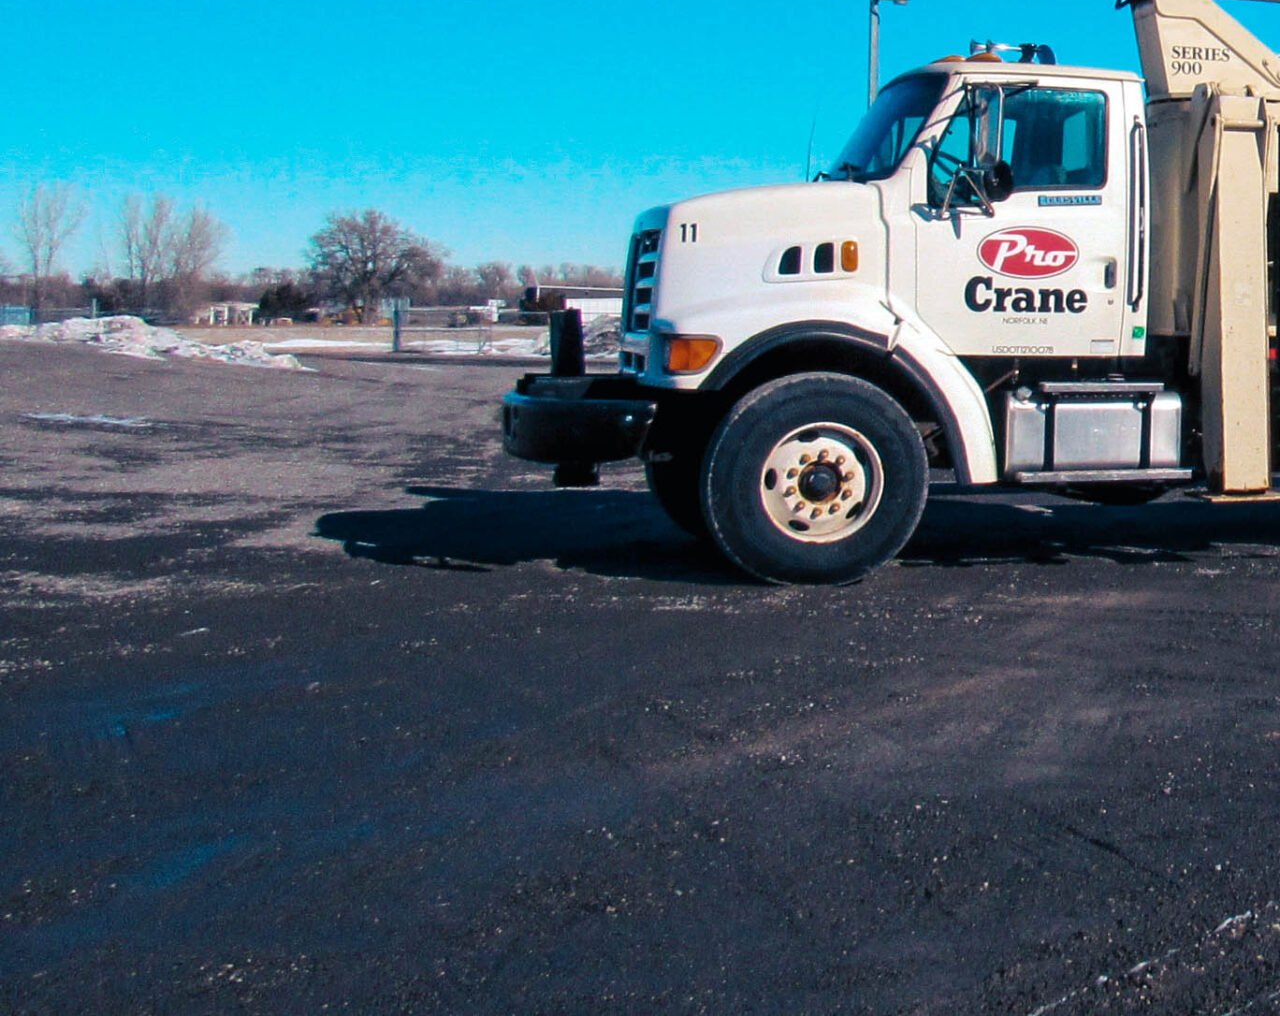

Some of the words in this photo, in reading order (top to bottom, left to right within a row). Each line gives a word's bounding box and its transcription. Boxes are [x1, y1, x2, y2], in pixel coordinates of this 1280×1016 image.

[1171, 45, 1231, 62] SERIES
[1171, 60, 1203, 76] 900
[680, 223, 697, 243] 11
[986, 233, 1078, 272] Pro
[964, 275, 1088, 314] Crane
